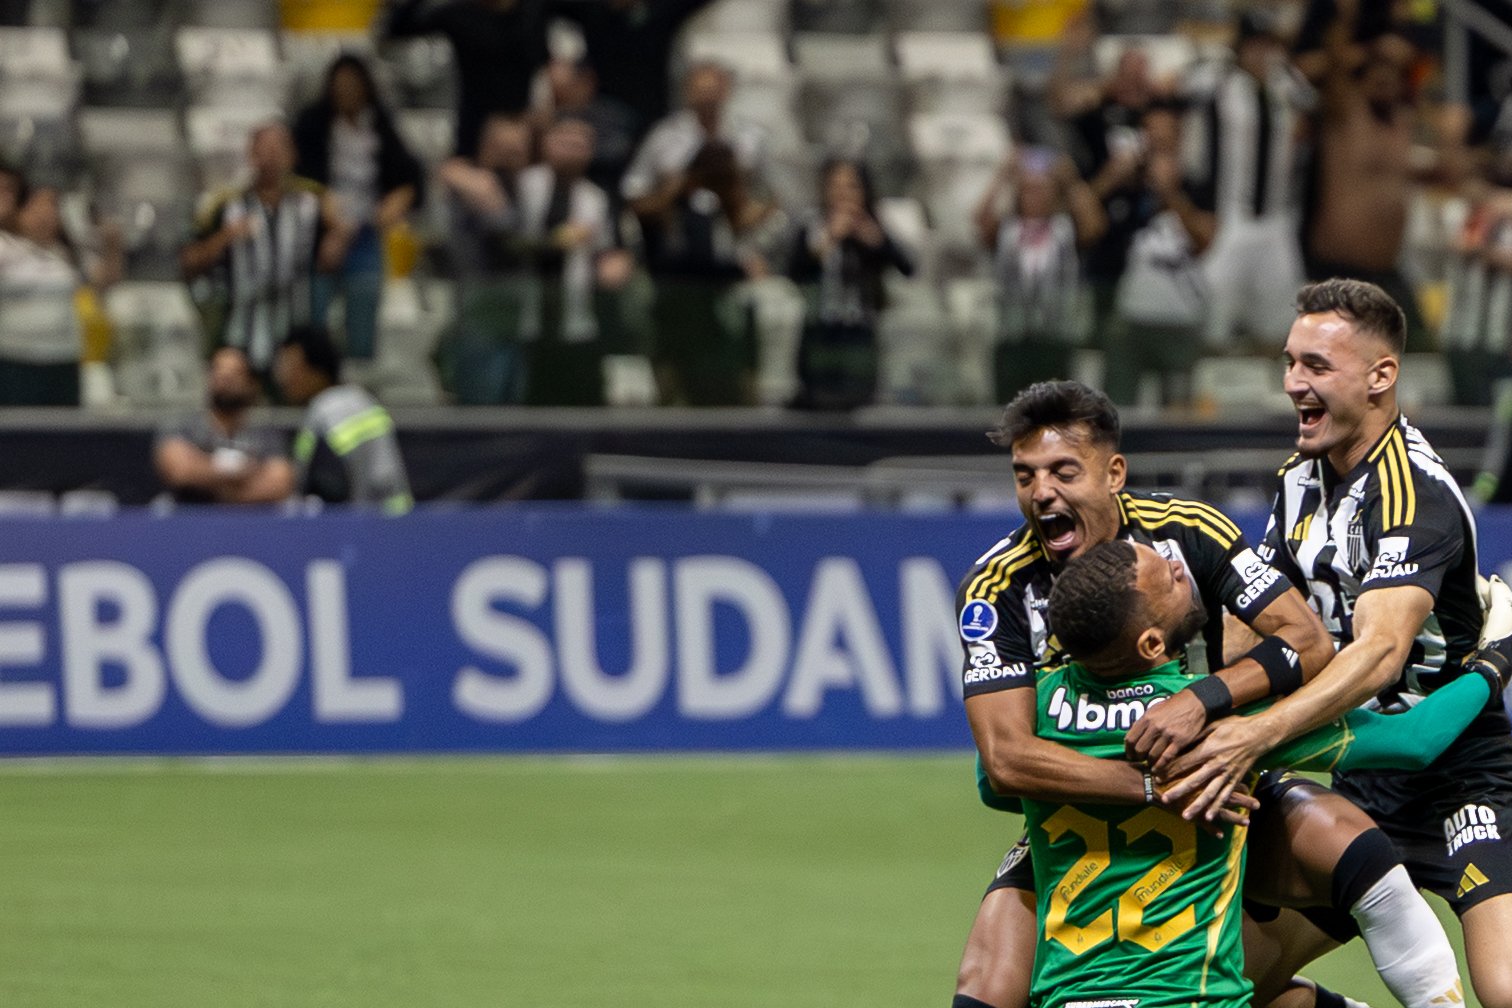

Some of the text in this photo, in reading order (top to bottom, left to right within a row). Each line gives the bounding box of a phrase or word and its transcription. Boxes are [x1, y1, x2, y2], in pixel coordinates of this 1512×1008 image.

[964, 662, 1027, 684] GERDAU
[1106, 684, 1154, 699] banco
[1077, 693, 1171, 731] bm
[1443, 803, 1496, 842] AUTO
[1446, 824, 1502, 857] TRUCK
[1040, 804, 1197, 956] 22
